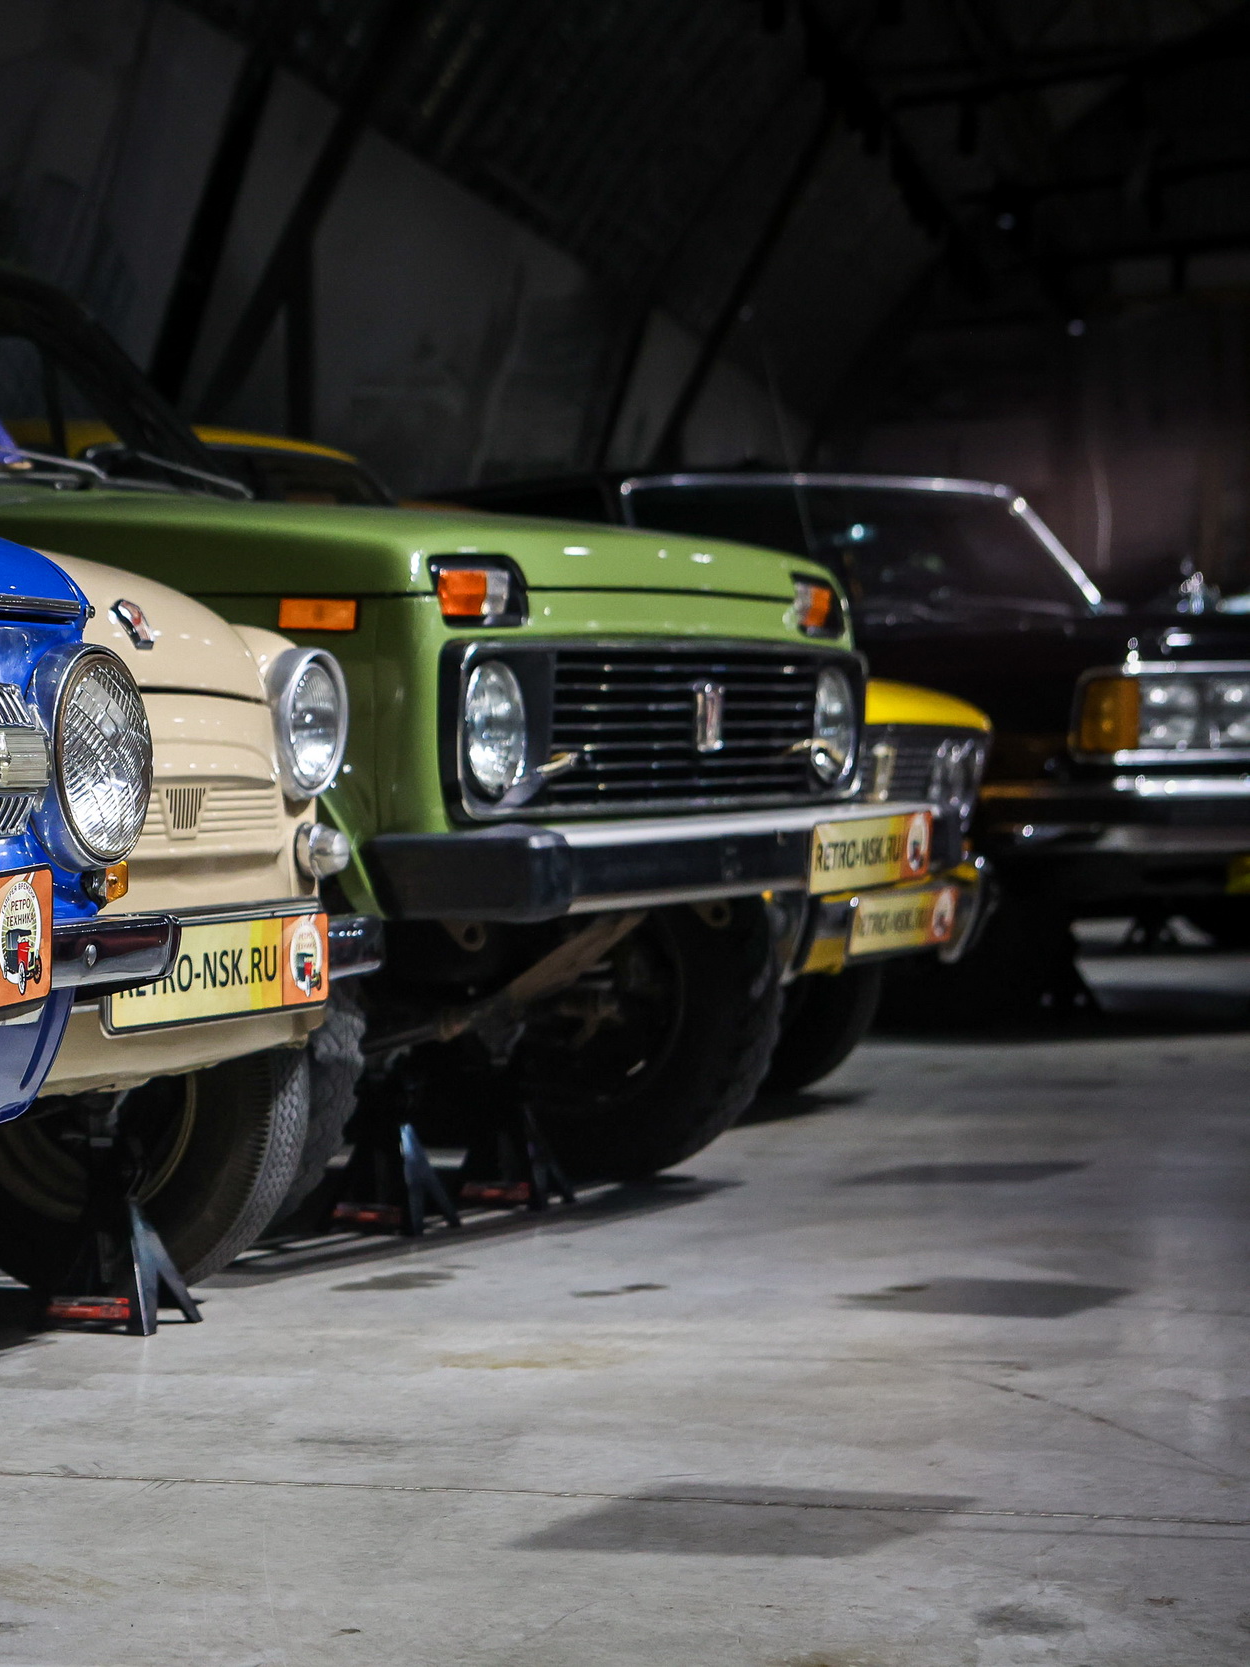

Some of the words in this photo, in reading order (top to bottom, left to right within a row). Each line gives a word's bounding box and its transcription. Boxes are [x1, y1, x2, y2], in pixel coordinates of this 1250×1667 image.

[10, 898, 31, 911] РЕТРО
[6, 912, 36, 927] ТЕХНИКА
[119, 945, 277, 999] O-NSK.RU
